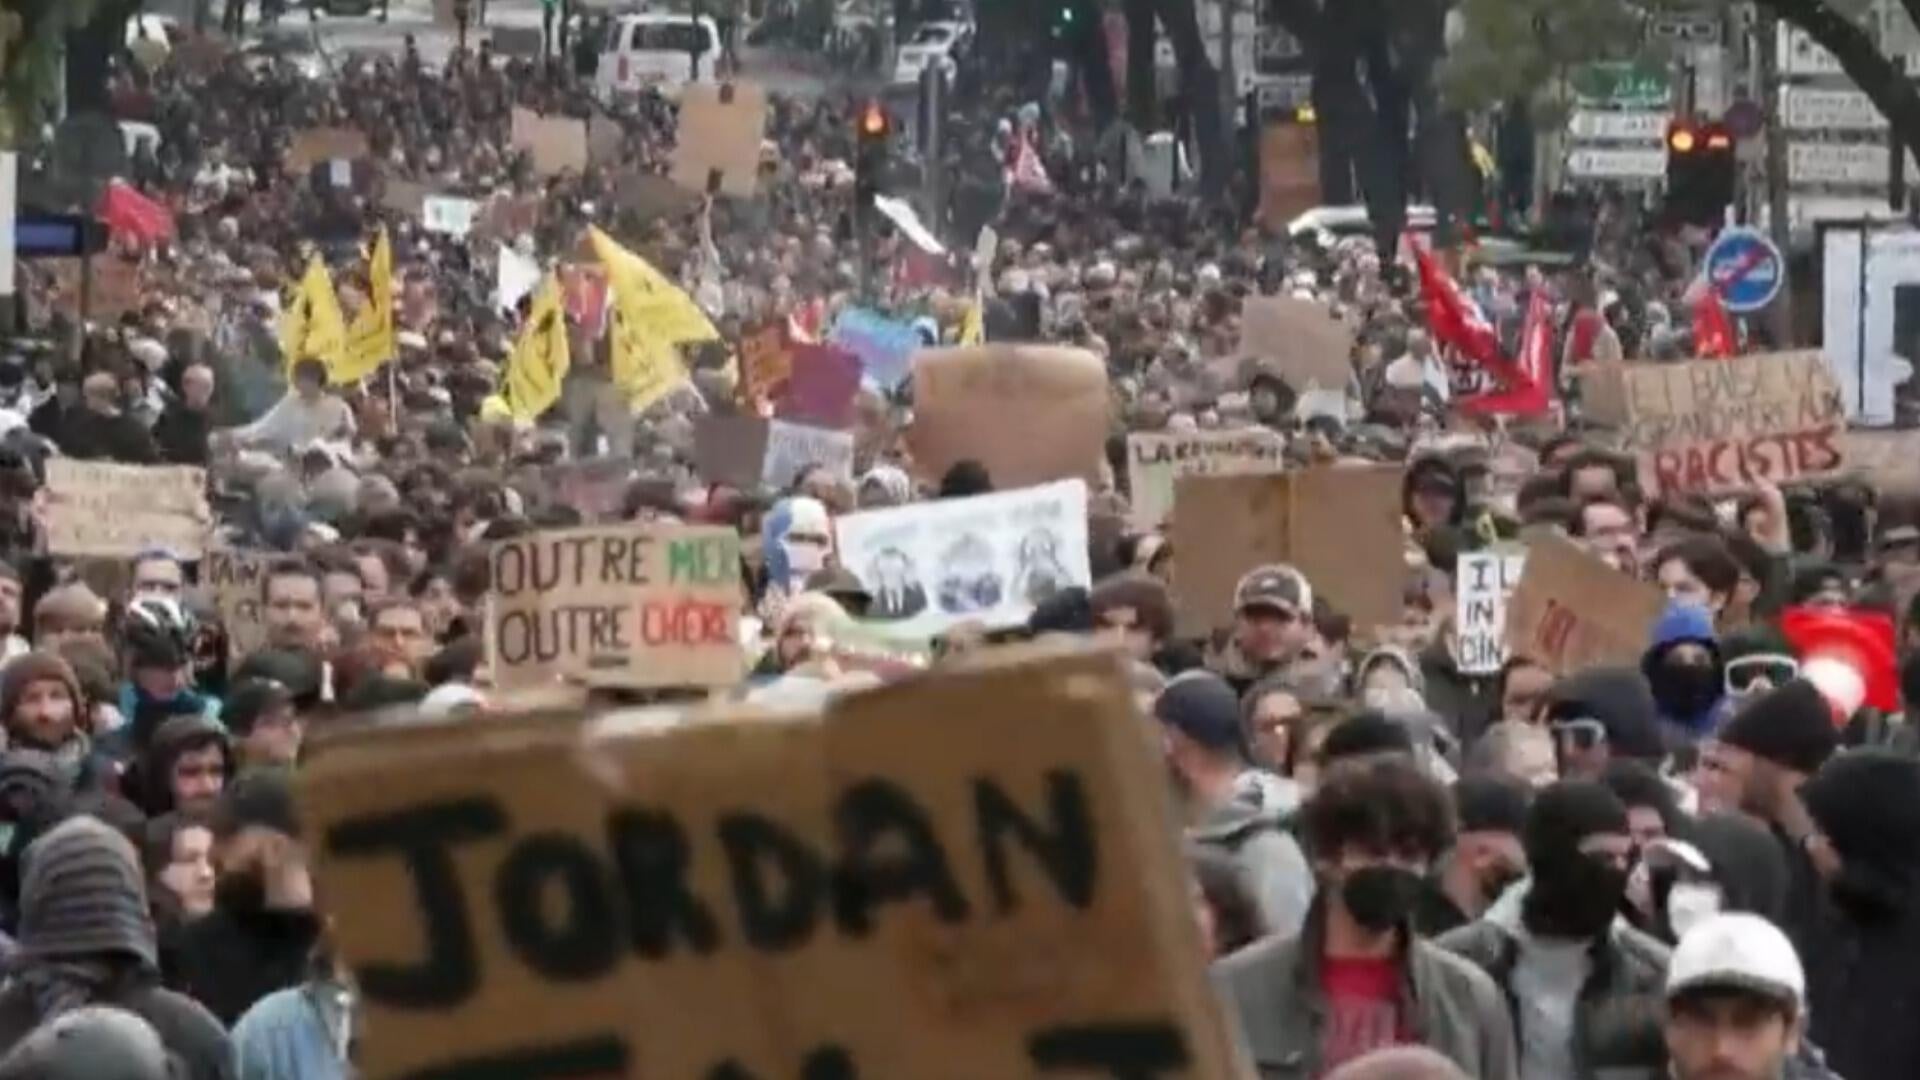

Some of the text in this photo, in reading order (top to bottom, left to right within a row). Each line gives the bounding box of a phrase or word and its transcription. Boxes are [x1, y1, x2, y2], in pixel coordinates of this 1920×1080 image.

[1135, 441, 1171, 465] LA
[1655, 423, 1841, 491] RACISTES
[497, 536, 655, 596] OUTRE
[500, 603, 632, 667] OUTRE
[325, 768, 1097, 1012] JORDAN
